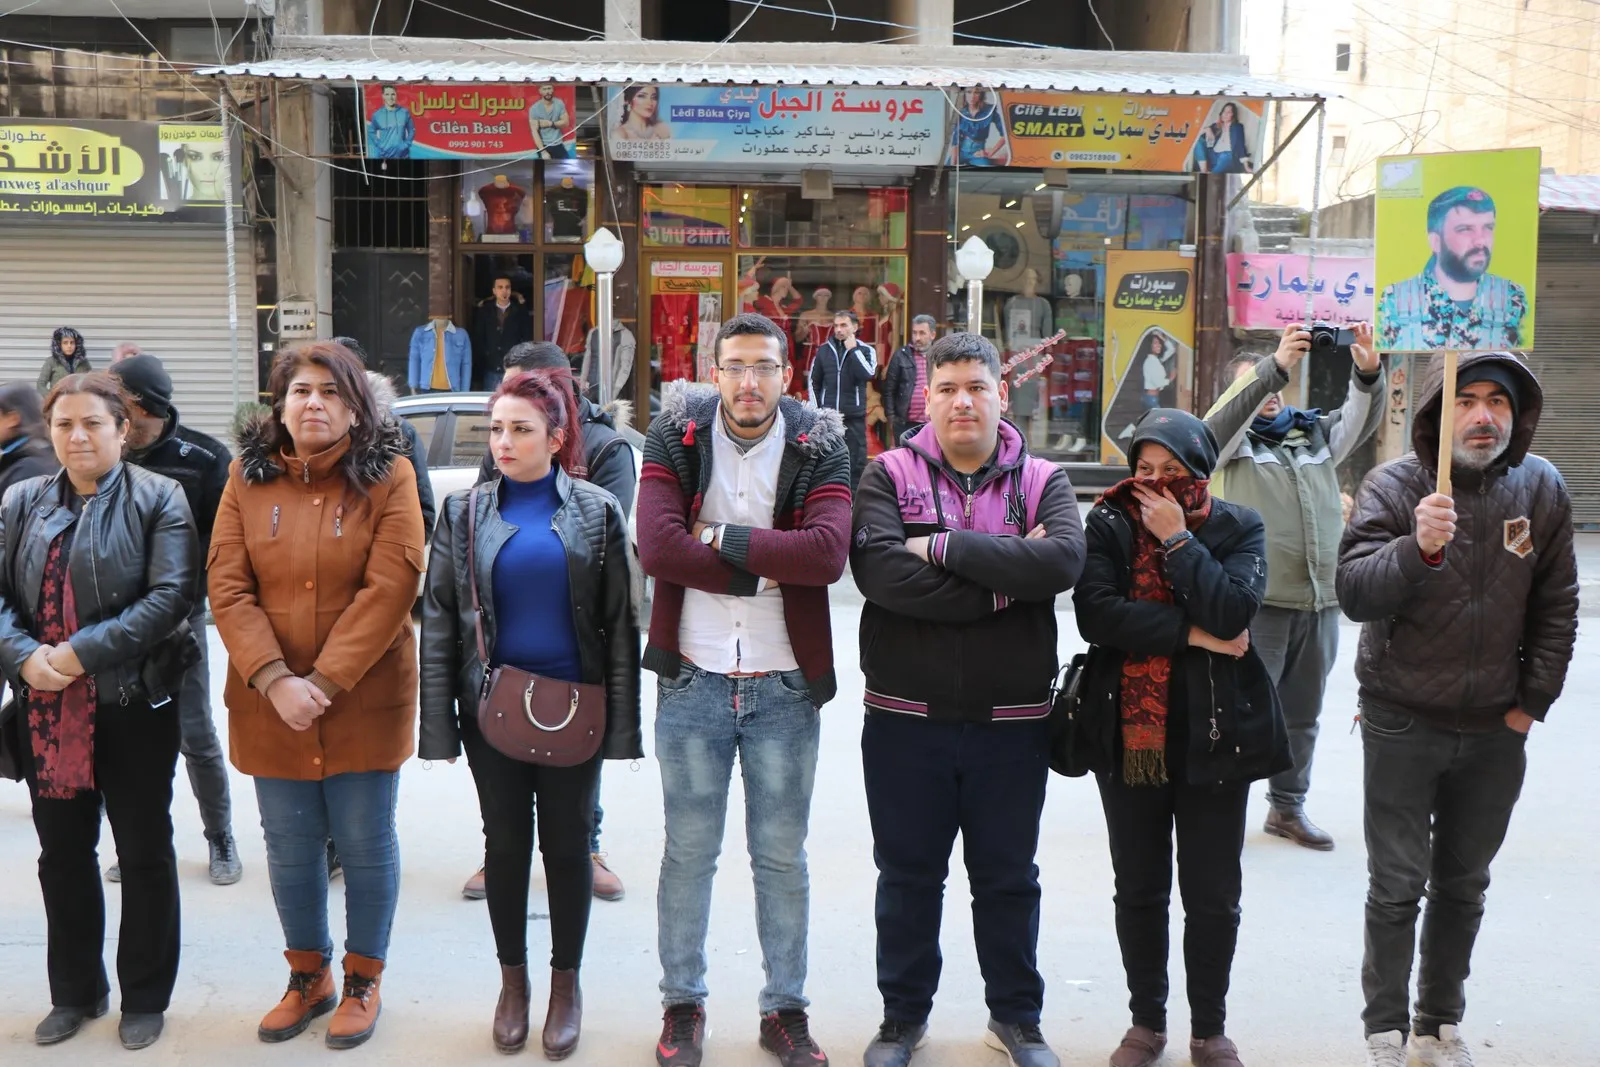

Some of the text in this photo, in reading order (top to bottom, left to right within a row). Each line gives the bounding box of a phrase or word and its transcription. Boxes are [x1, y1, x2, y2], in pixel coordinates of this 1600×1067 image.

[719, 87, 760, 104] ليدي
[411, 91, 526, 117] سبورات باسل
[757, 89, 924, 122] عروسة الجبل
[1122, 100, 1170, 120] سبورات
[697, 108, 724, 118] Bûka
[727, 108, 750, 121] Çiya
[430, 120, 512, 135] Cilên Basêl
[733, 124, 785, 139] مكياجات
[795, 125, 836, 139] بشاكير
[897, 127, 931, 142] تجهيز
[1013, 121, 1082, 136] SMART
[1093, 118, 1191, 144] ليدي سمارت
[471, 141, 486, 149] 901
[742, 143, 789, 157] عطورات
[794, 143, 831, 157] تركيب
[844, 143, 885, 157] داخلية
[46, 179, 111, 193] al'ashqur
[31, 201, 97, 216] إكسسوارات
[108, 203, 165, 216] مكياجات
[1130, 274, 1176, 294] سبورات
[1118, 291, 1183, 310] ليدي سمارت
[1003, 492, 1026, 525] N
